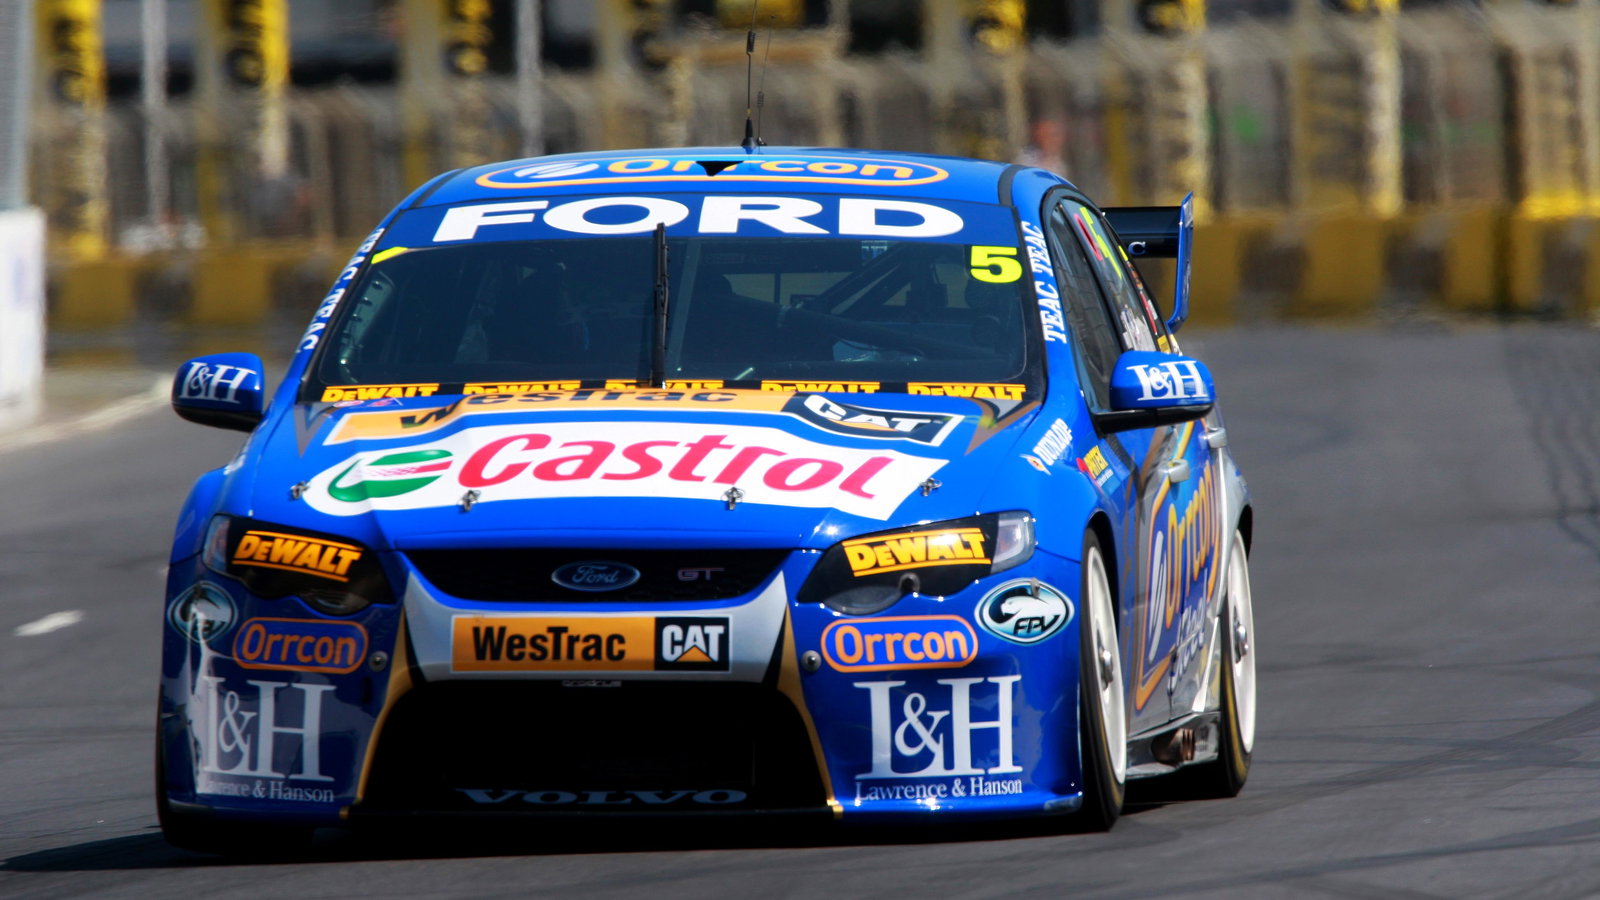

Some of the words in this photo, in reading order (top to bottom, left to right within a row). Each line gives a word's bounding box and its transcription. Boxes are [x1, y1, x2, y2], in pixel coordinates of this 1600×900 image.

[433, 196, 964, 242] FORD
[970, 246, 1023, 284] 5
[1021, 221, 1054, 277] TEAC
[1034, 281, 1067, 344] TEAC
[179, 361, 257, 404] L&H
[1126, 360, 1208, 401] L&H
[804, 395, 931, 432] CAT
[458, 432, 895, 500] Castrol
[234, 535, 362, 576] DEWALT
[843, 533, 987, 572] DEWALT
[572, 564, 619, 584] Ford
[677, 568, 724, 581] GT
[472, 625, 626, 662] WesTrac
[662, 624, 724, 662] CAT
[1013, 614, 1060, 634] FPV
[242, 623, 356, 665] Orrcon
[835, 625, 969, 663] Orrcon
[203, 675, 337, 782] L&H
[853, 674, 1023, 779] L&H
[252, 779, 266, 798] &
[269, 780, 335, 802] Hanson
[454, 788, 747, 804] VOLVO
[855, 781, 947, 801] Lawrence
[952, 777, 966, 796] &
[970, 776, 1023, 796] Hanson
